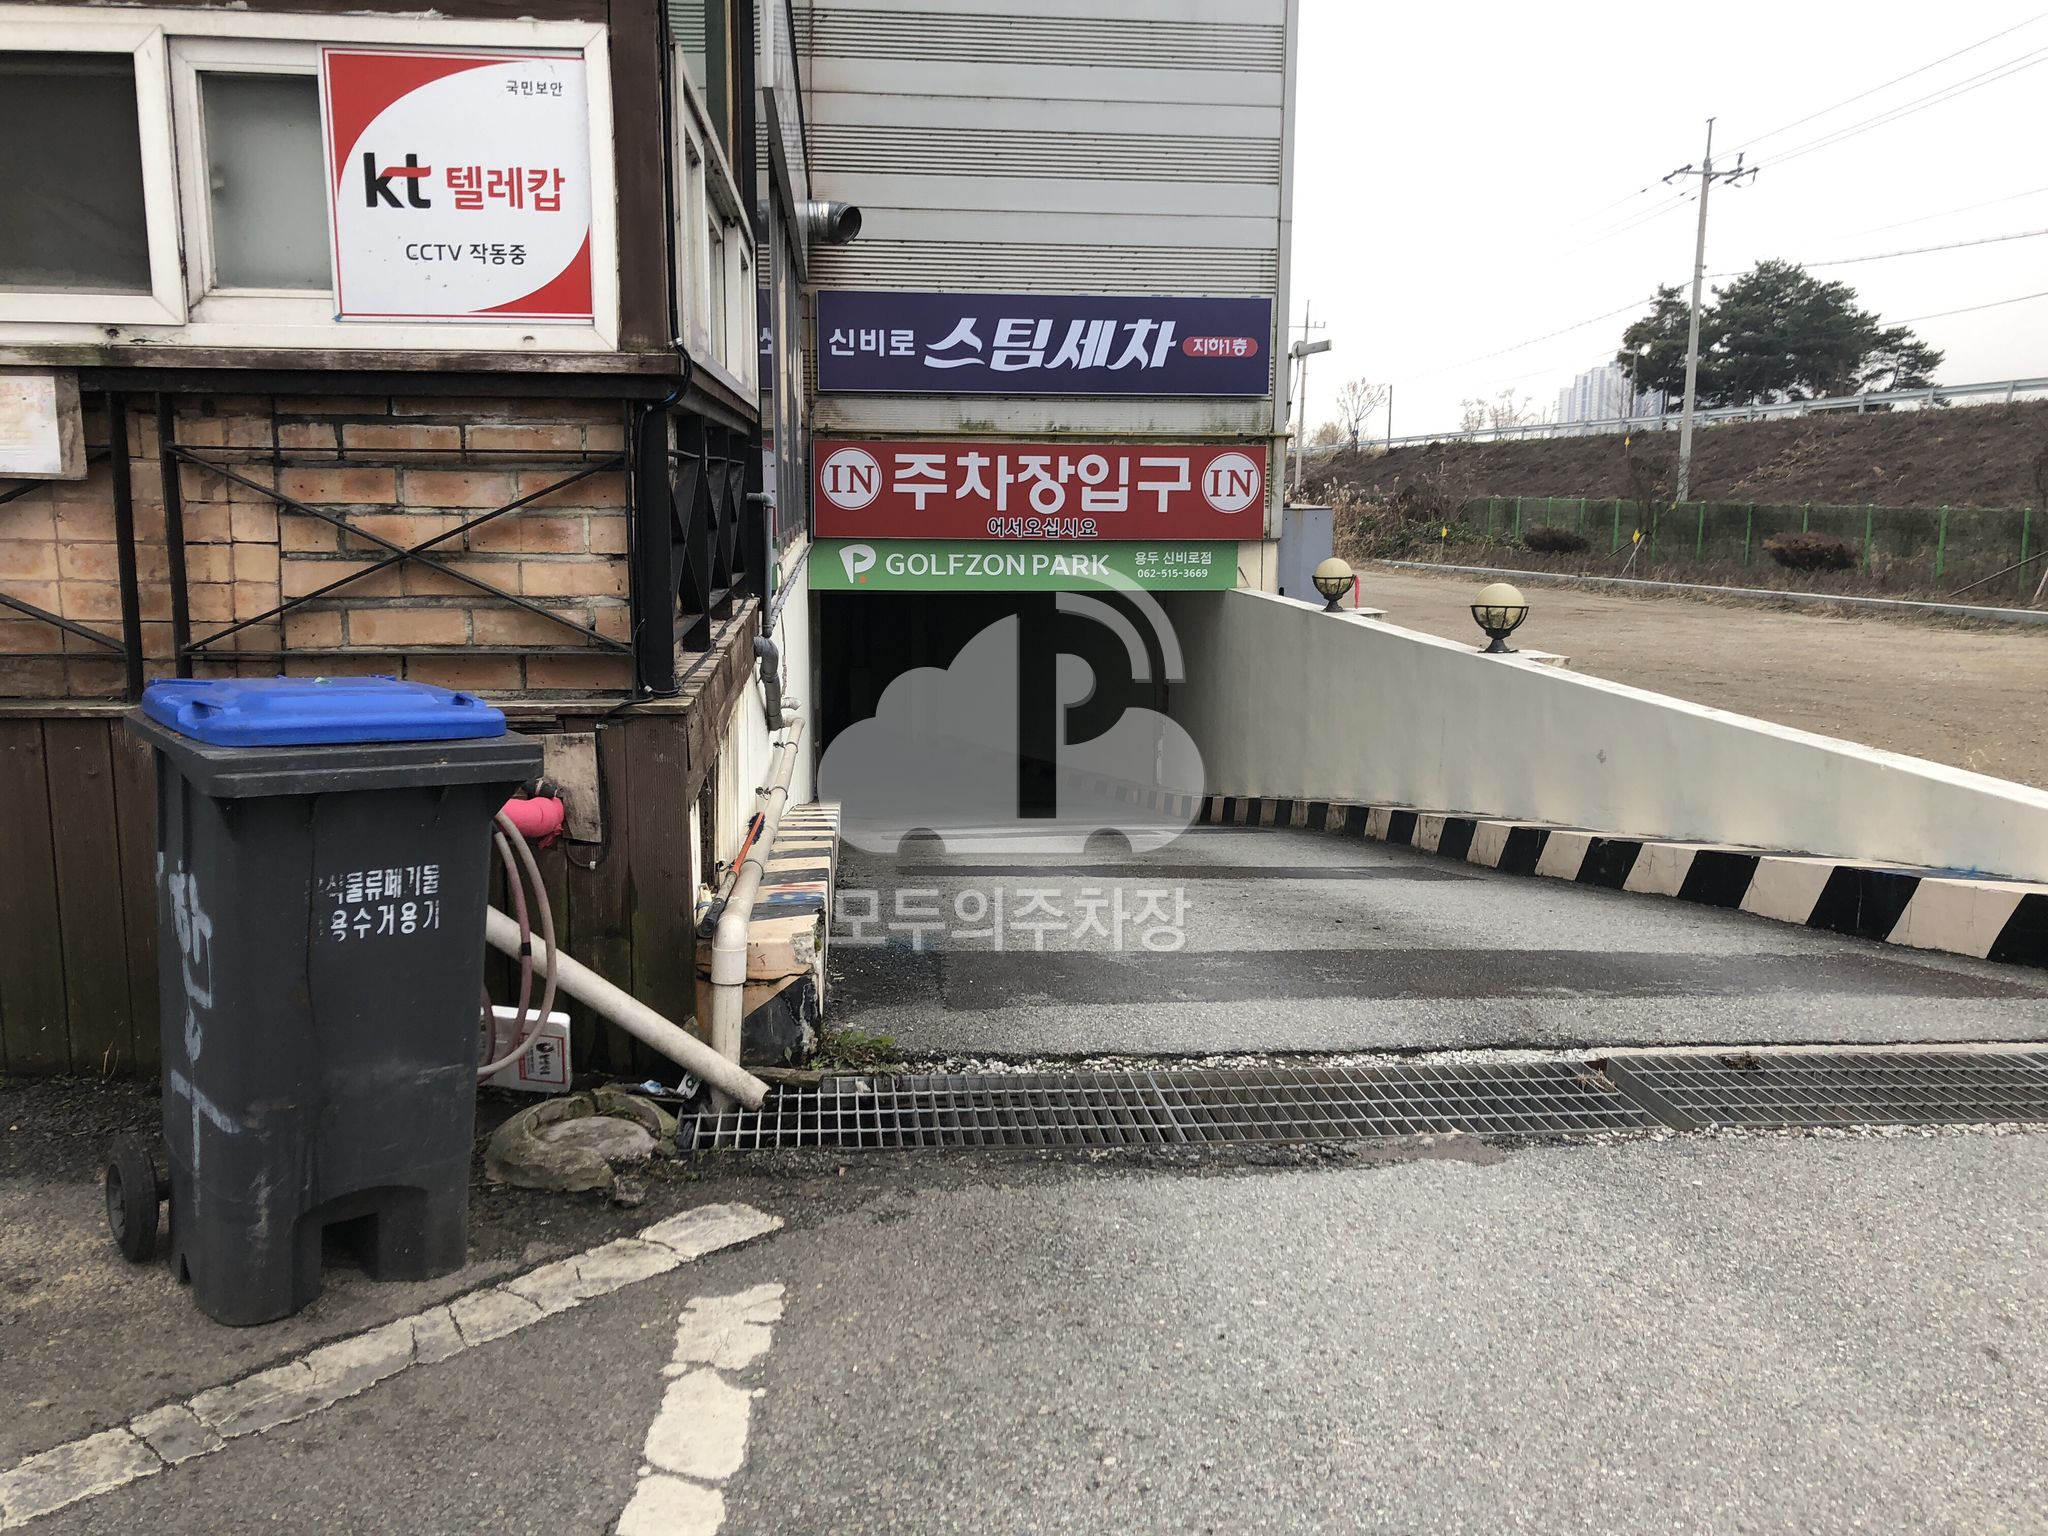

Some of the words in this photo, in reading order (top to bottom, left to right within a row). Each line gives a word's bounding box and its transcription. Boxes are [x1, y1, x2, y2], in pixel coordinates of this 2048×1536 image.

[505, 79, 563, 97] 국민보안
[362, 151, 432, 210] kt
[445, 165, 566, 212] 텔레캅
[405, 243, 463, 262] CCTV
[468, 242, 528, 266] 작동중
[827, 327, 916, 358] 신비로
[922, 316, 1178, 372] 스팀세차
[1191, 336, 1248, 358] 지하1층
[828, 463, 876, 495] IN
[892, 450, 1192, 515] 주차장입구
[1209, 468, 1255, 499] IN
[985, 516, 1099, 539] 어서오십시요
[884, 552, 1025, 577] GOLFZON
[1031, 553, 1111, 577] PARK
[1134, 551, 1159, 566] 용두
[1162, 551, 1212, 566] 신비로점
[1136, 568, 1209, 579] 062-515-3669
[304, 863, 441, 906] 식물류폐기물
